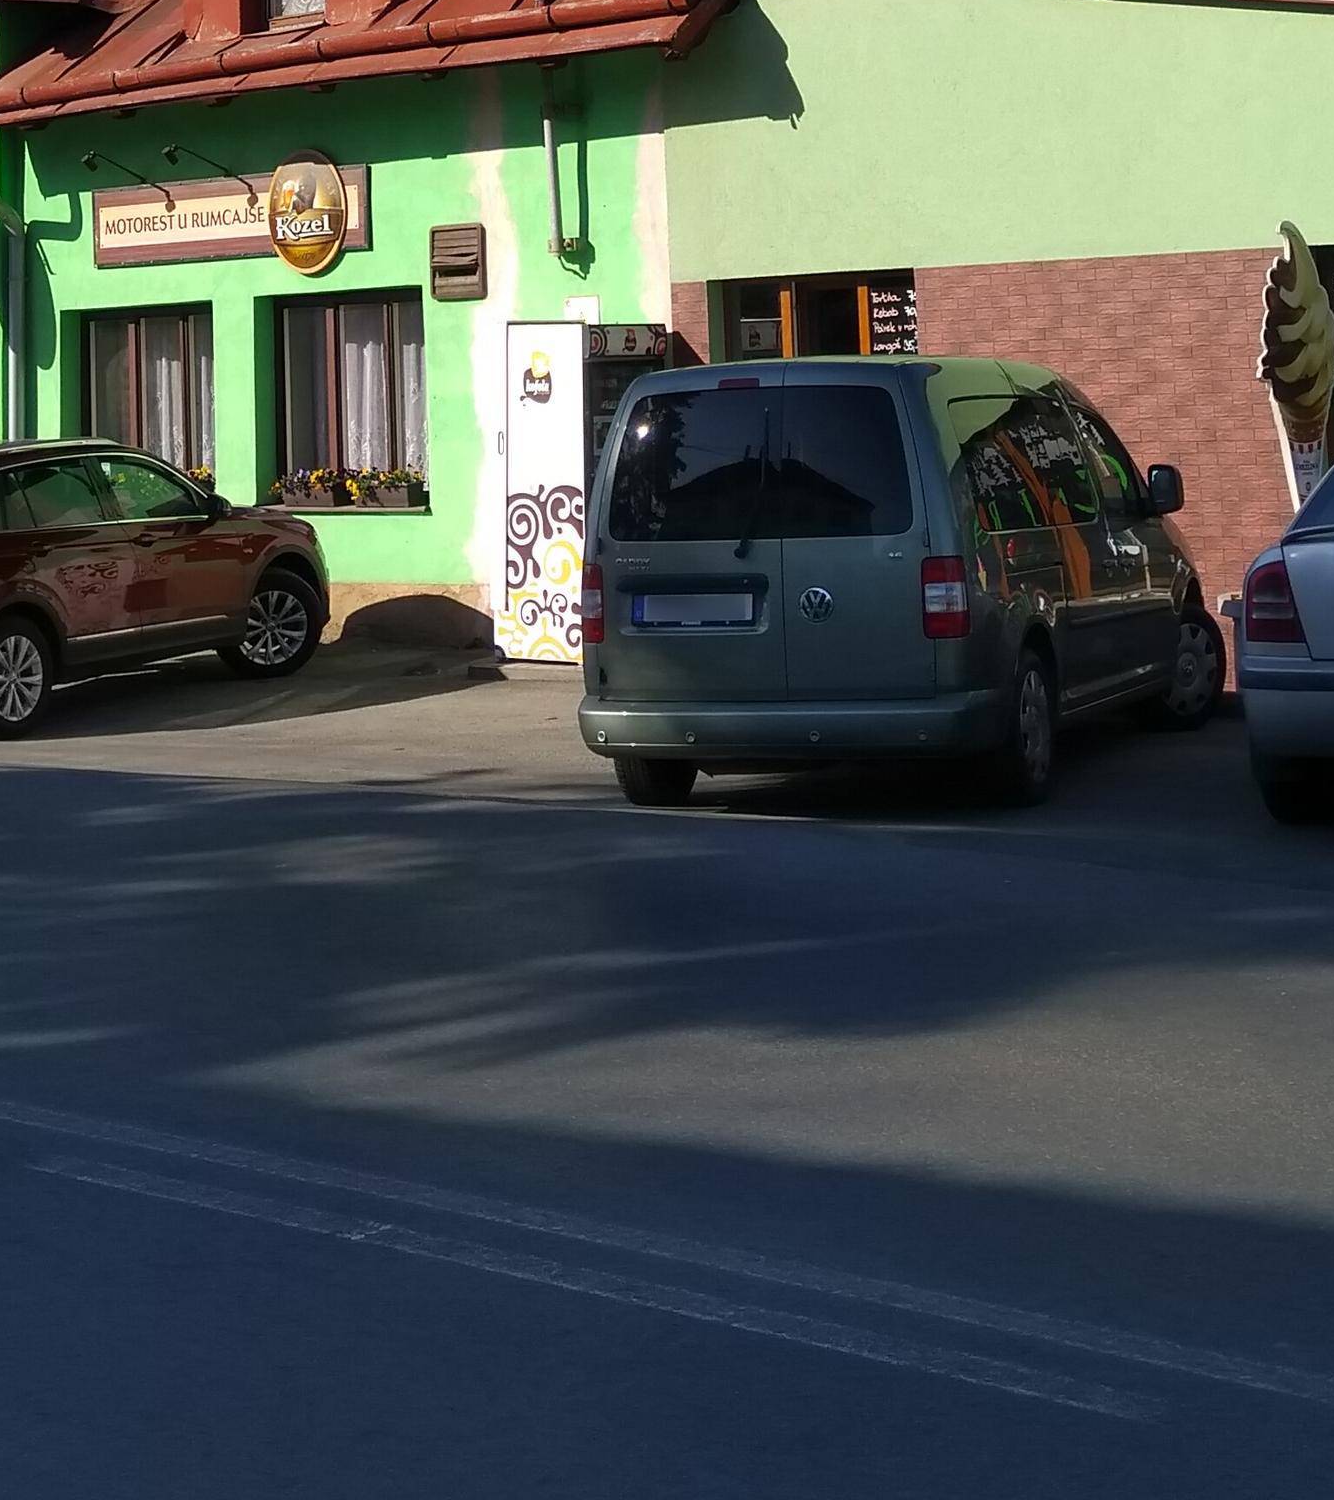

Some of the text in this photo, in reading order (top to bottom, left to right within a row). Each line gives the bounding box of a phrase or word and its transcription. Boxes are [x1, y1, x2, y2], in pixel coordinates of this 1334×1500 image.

[104, 206, 265, 235] MOTOREST U RUMCAJSE
[275, 212, 332, 240] Kozel
